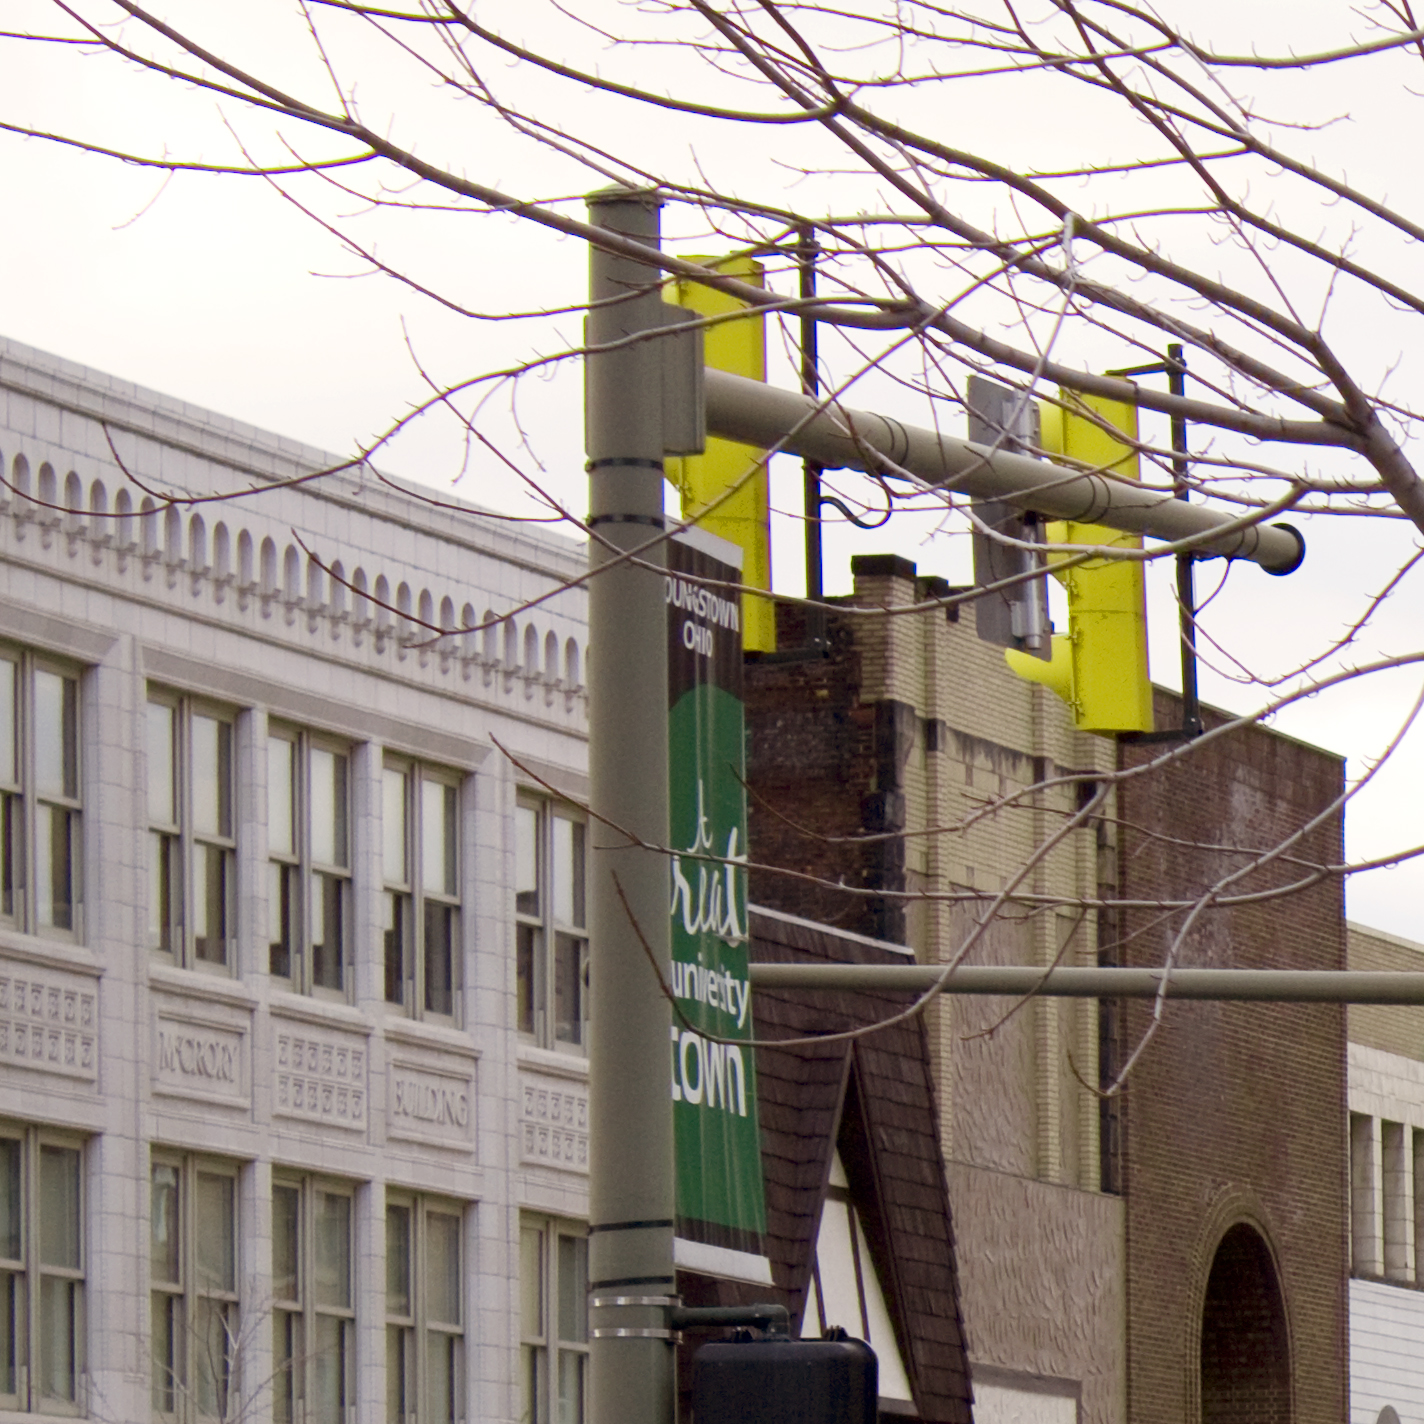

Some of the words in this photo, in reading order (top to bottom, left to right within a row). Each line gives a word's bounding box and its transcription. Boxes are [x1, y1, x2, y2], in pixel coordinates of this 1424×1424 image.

[665, 576, 739, 632] OUNGSTOWN
[683, 620, 713, 658] OHIO
[670, 826, 747, 938] reat
[394, 1079, 468, 1127] BUILDING
